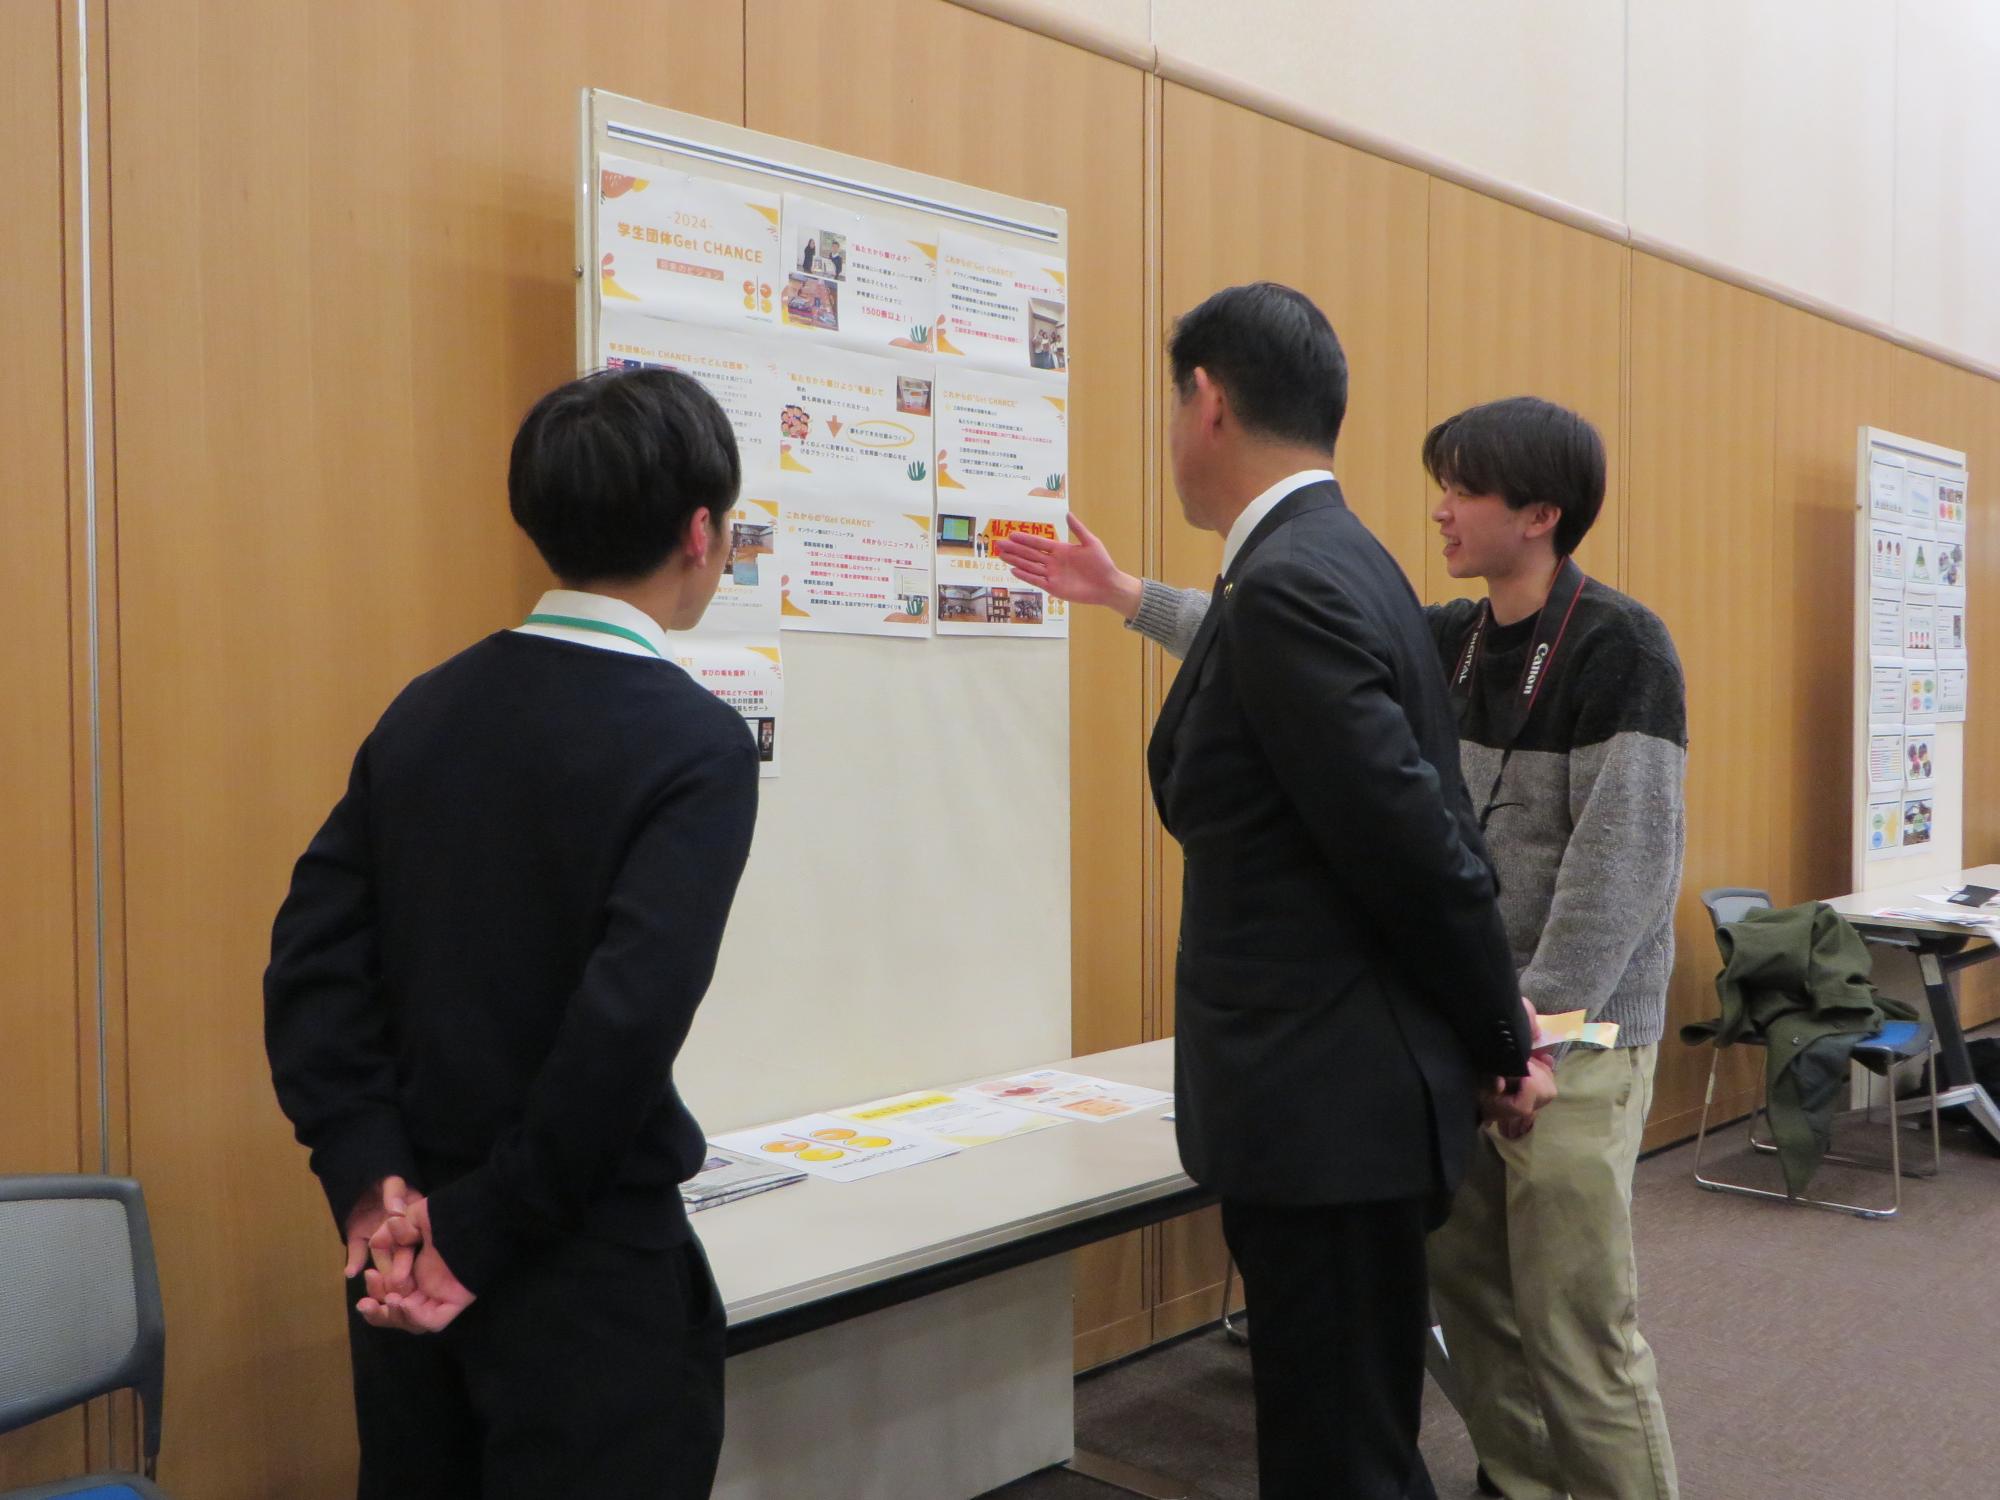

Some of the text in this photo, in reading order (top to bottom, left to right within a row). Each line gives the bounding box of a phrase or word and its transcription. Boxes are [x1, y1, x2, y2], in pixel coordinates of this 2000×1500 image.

[617, 222, 763, 264] 学生団体Get CHANCE
[1523, 643, 1549, 694] Canon
